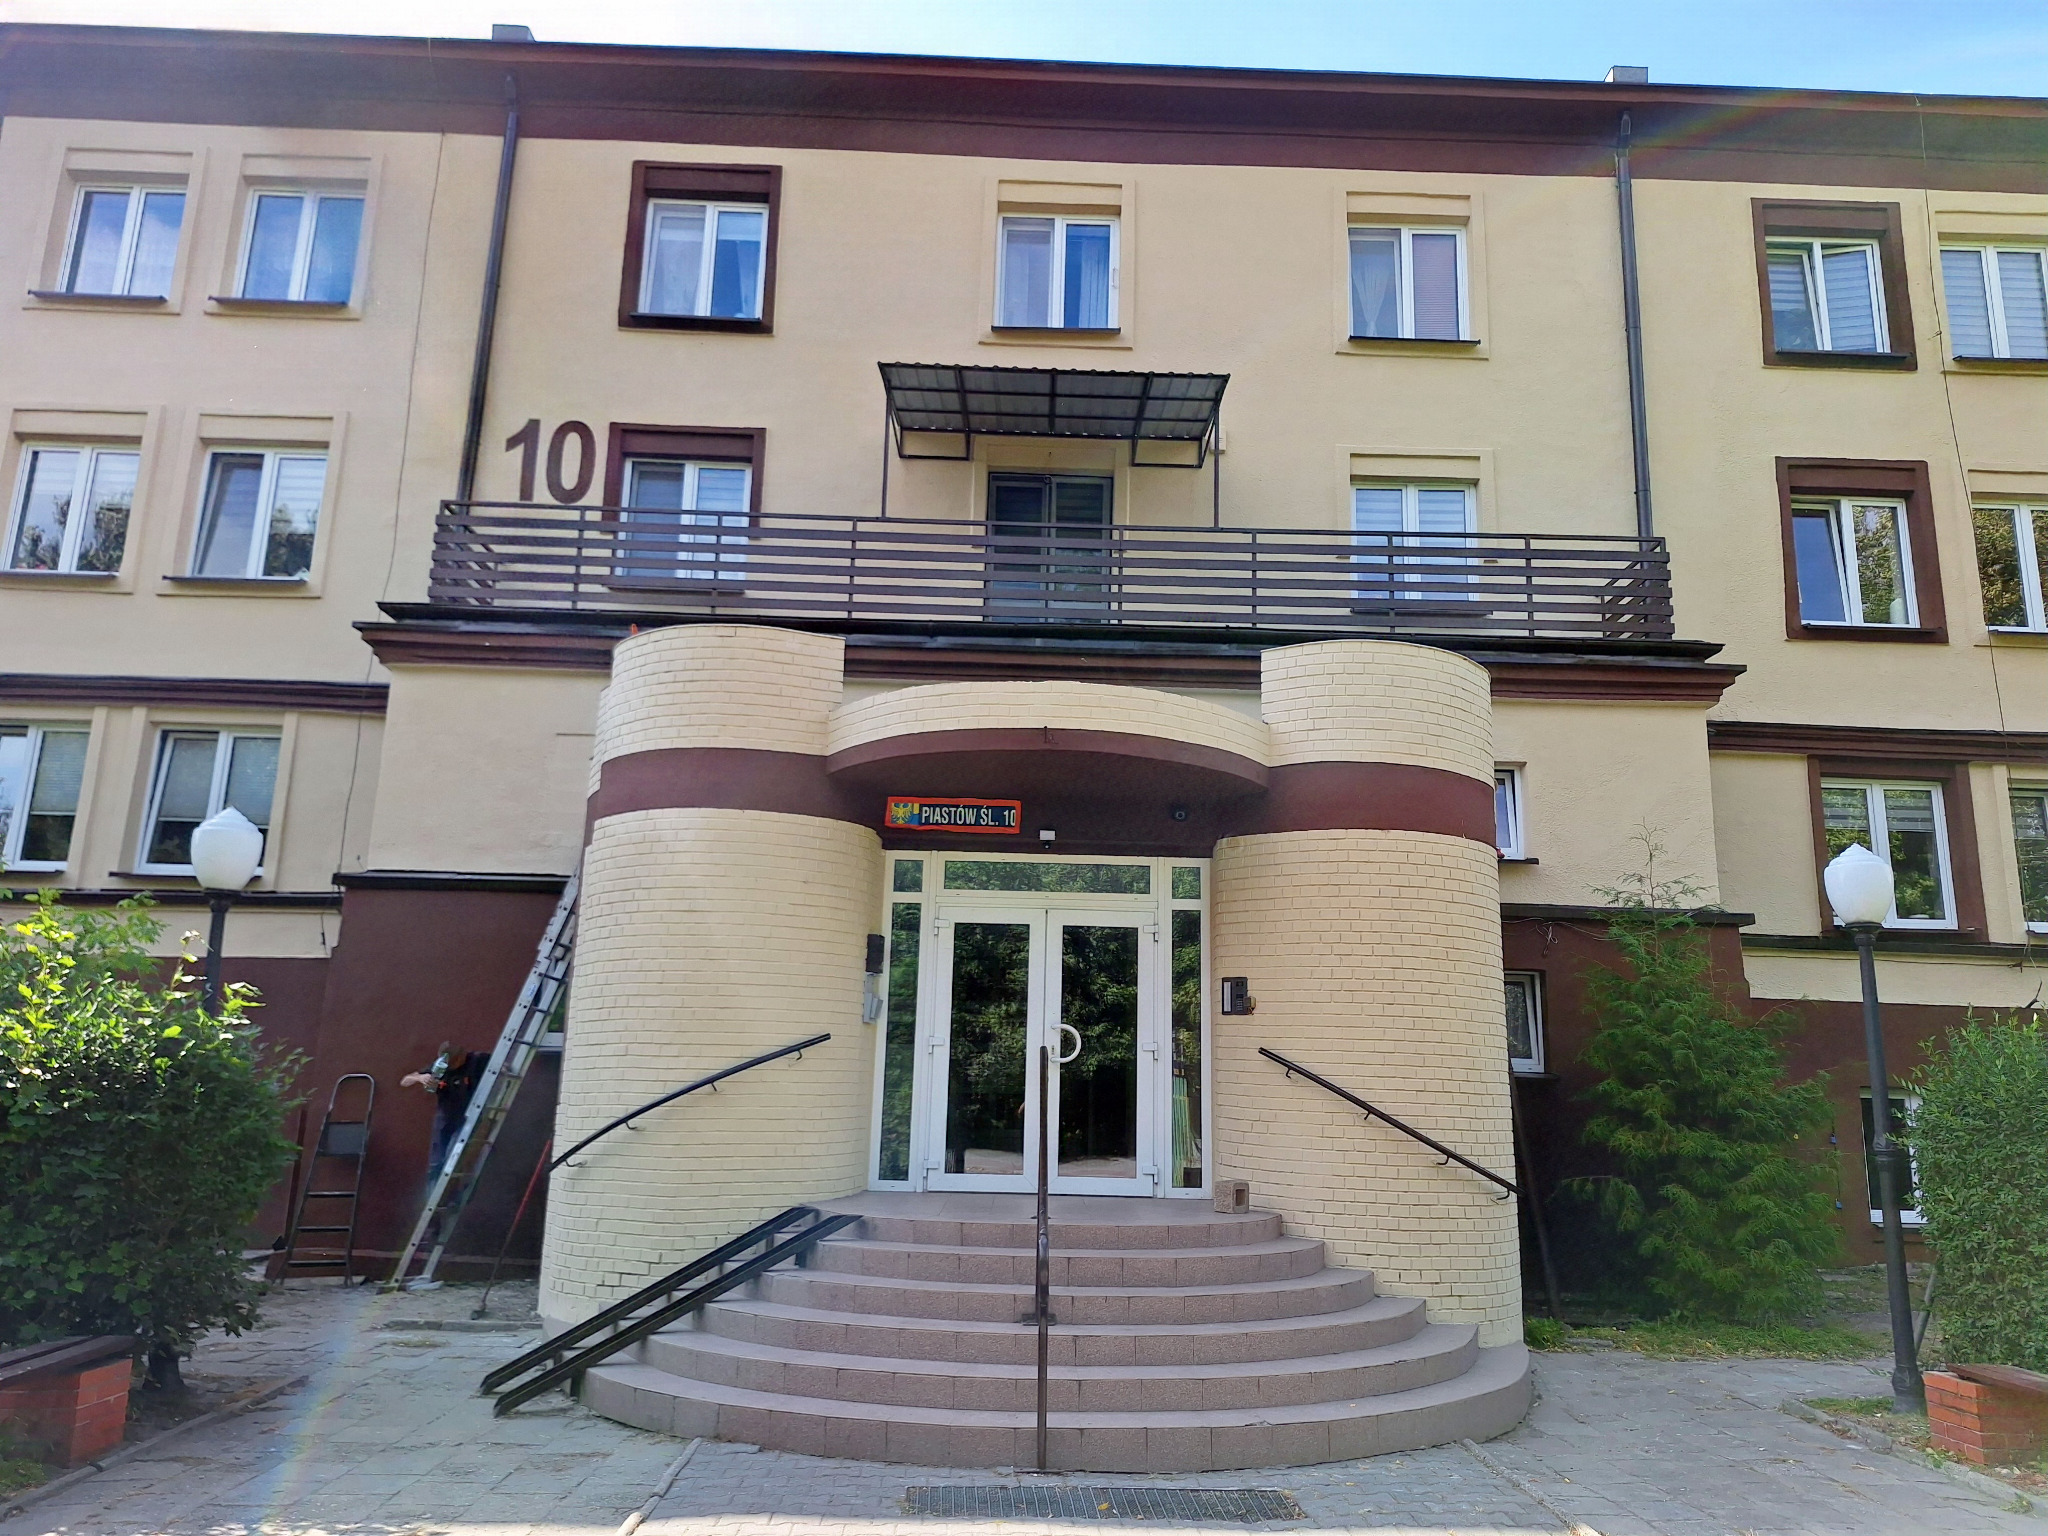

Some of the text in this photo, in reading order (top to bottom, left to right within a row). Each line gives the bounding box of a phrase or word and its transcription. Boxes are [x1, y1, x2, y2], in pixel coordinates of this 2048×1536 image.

[505, 418, 596, 504] 10
[921, 804, 1016, 827] PIASTÓW ŚL. 10
